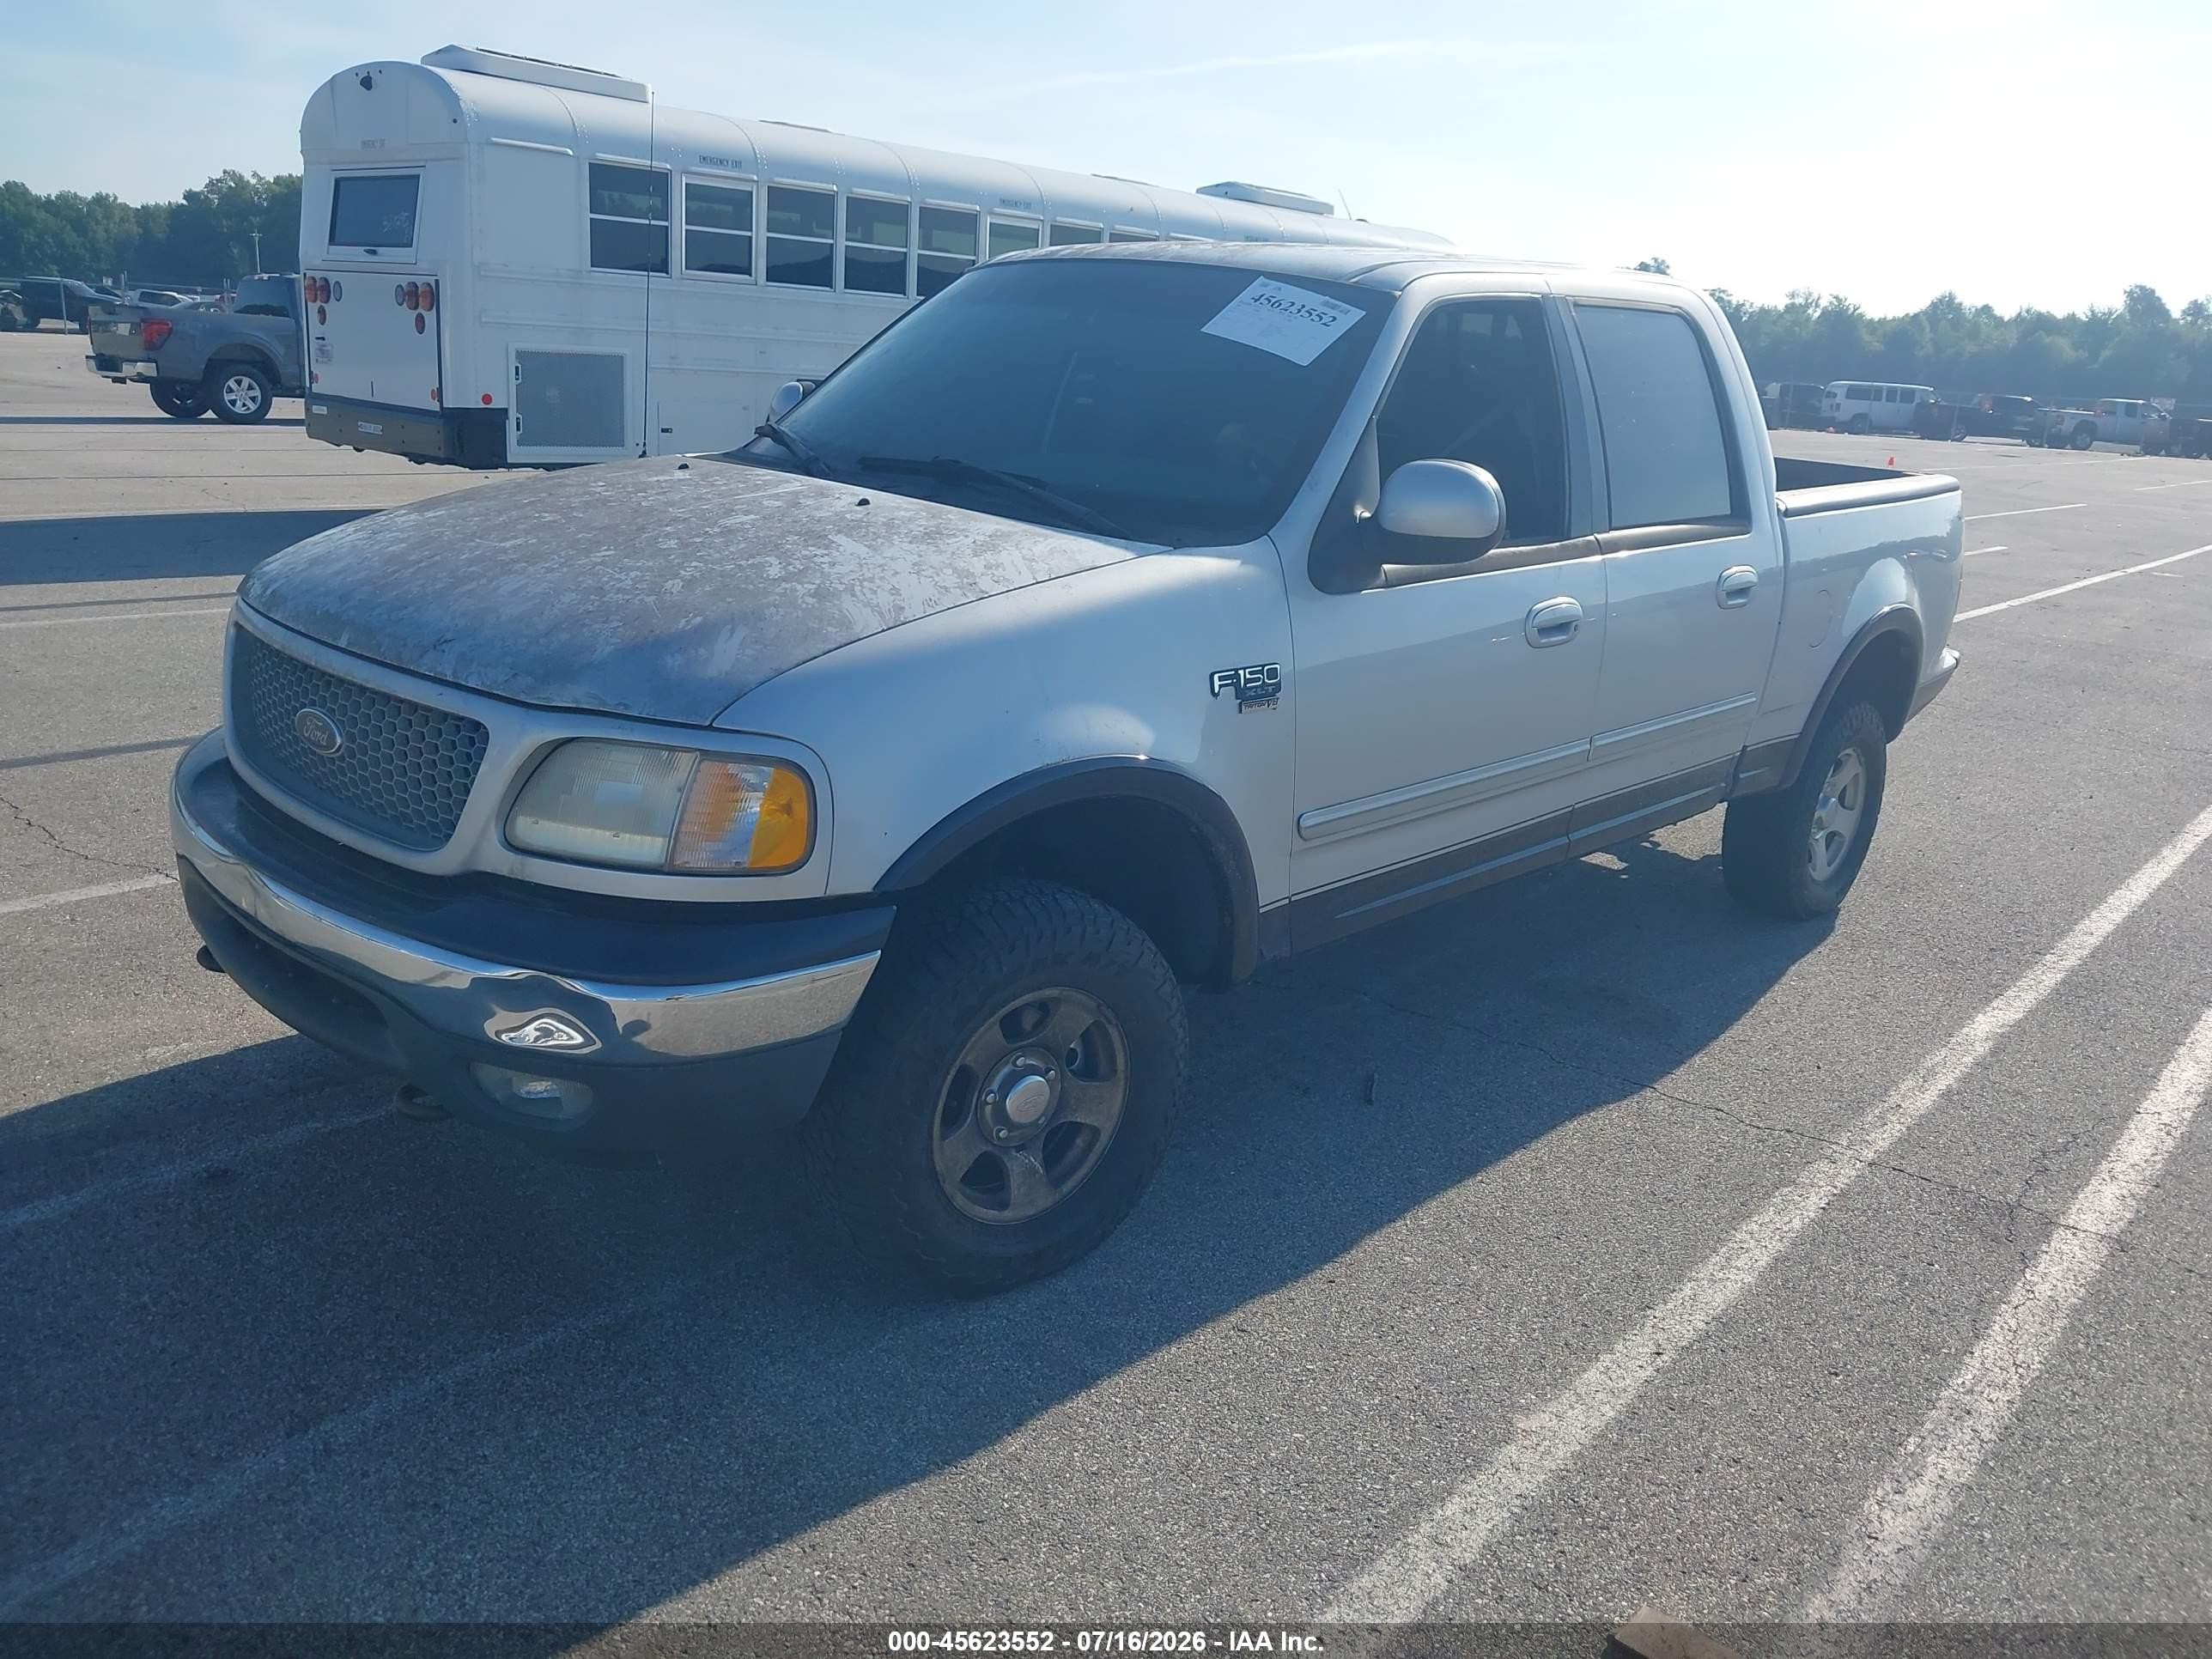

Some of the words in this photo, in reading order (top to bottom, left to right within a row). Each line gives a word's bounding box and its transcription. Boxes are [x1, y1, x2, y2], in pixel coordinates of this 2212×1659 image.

[1250, 293, 1338, 327] 45623552
[1245, 685, 1276, 696] XLT
[1243, 701, 1267, 711] TRITON
[1267, 698, 1279, 708] V8
[303, 716, 330, 745] Ford
